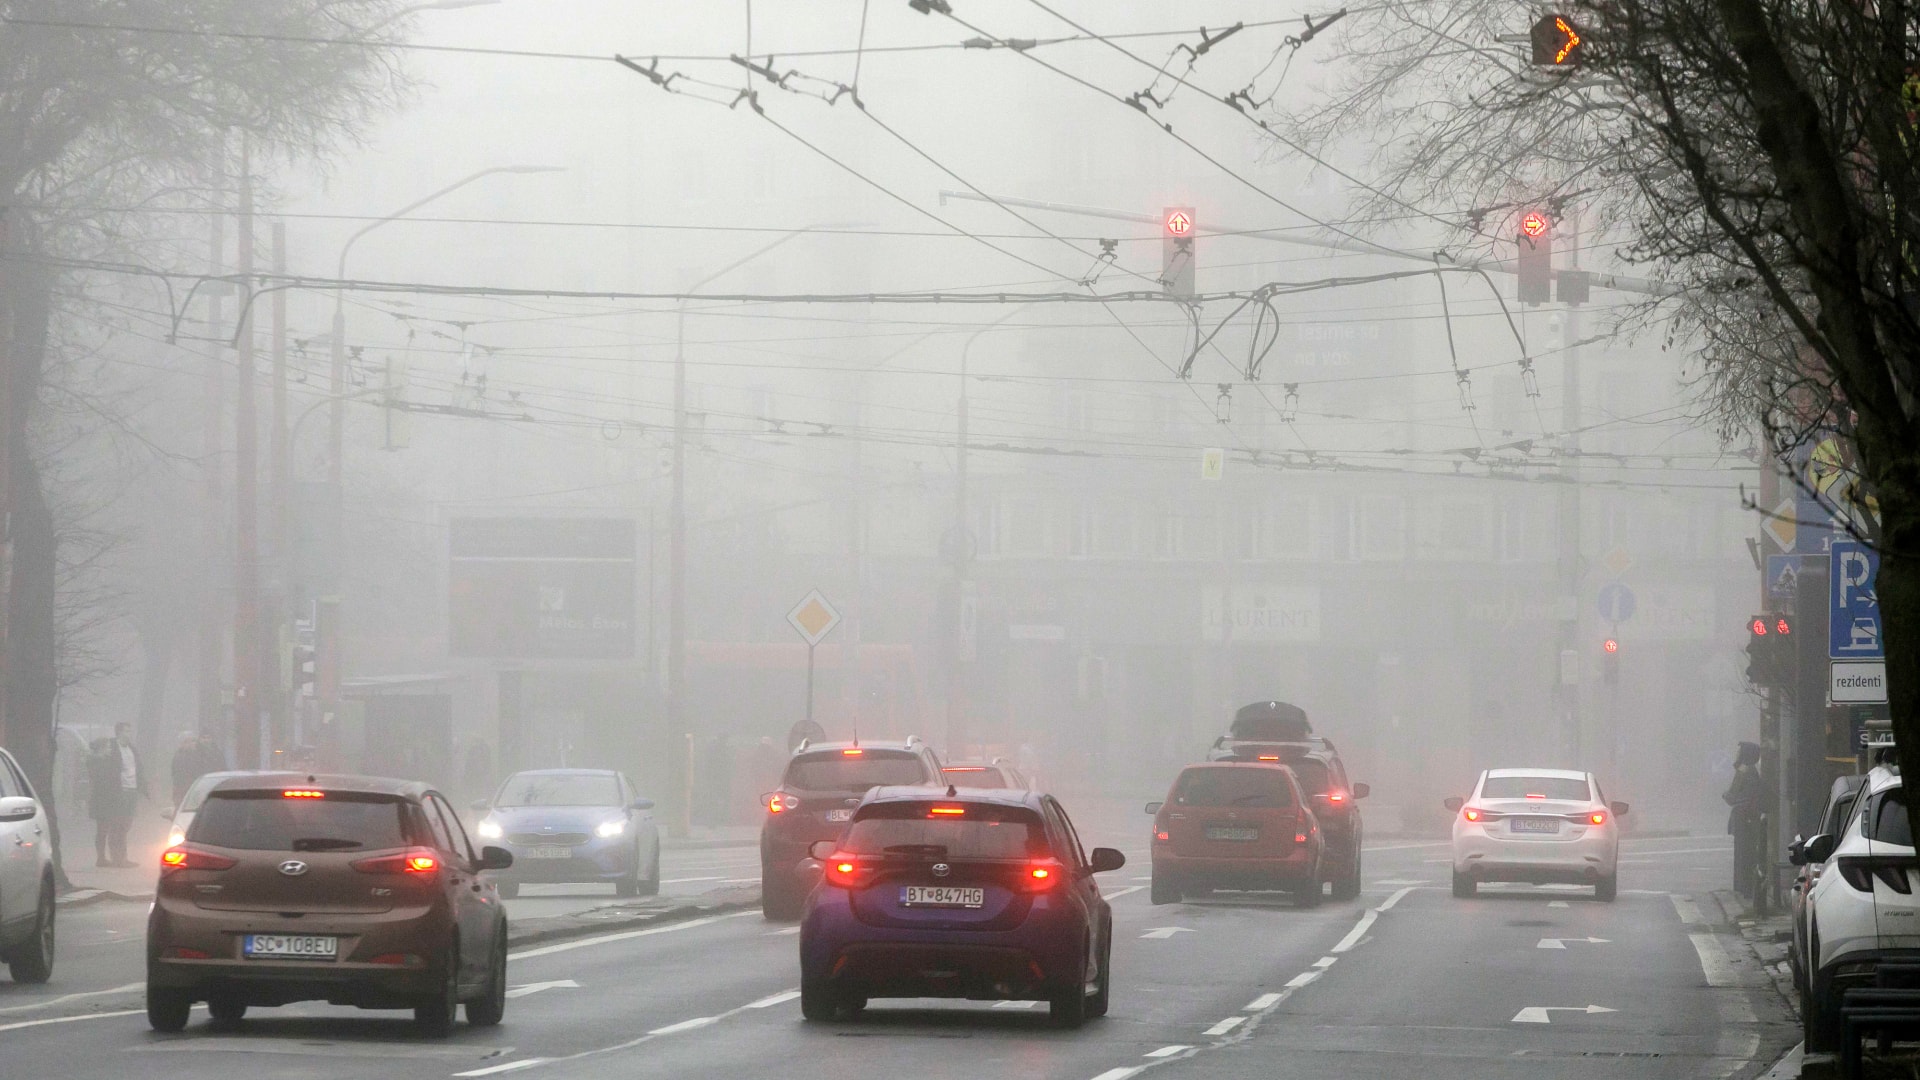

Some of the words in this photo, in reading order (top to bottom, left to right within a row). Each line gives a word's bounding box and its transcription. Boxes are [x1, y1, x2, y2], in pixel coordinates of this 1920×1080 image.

[1839, 552, 1870, 608] P
[1207, 608, 1313, 629] LAURENT
[1836, 674, 1882, 688] rezidenti
